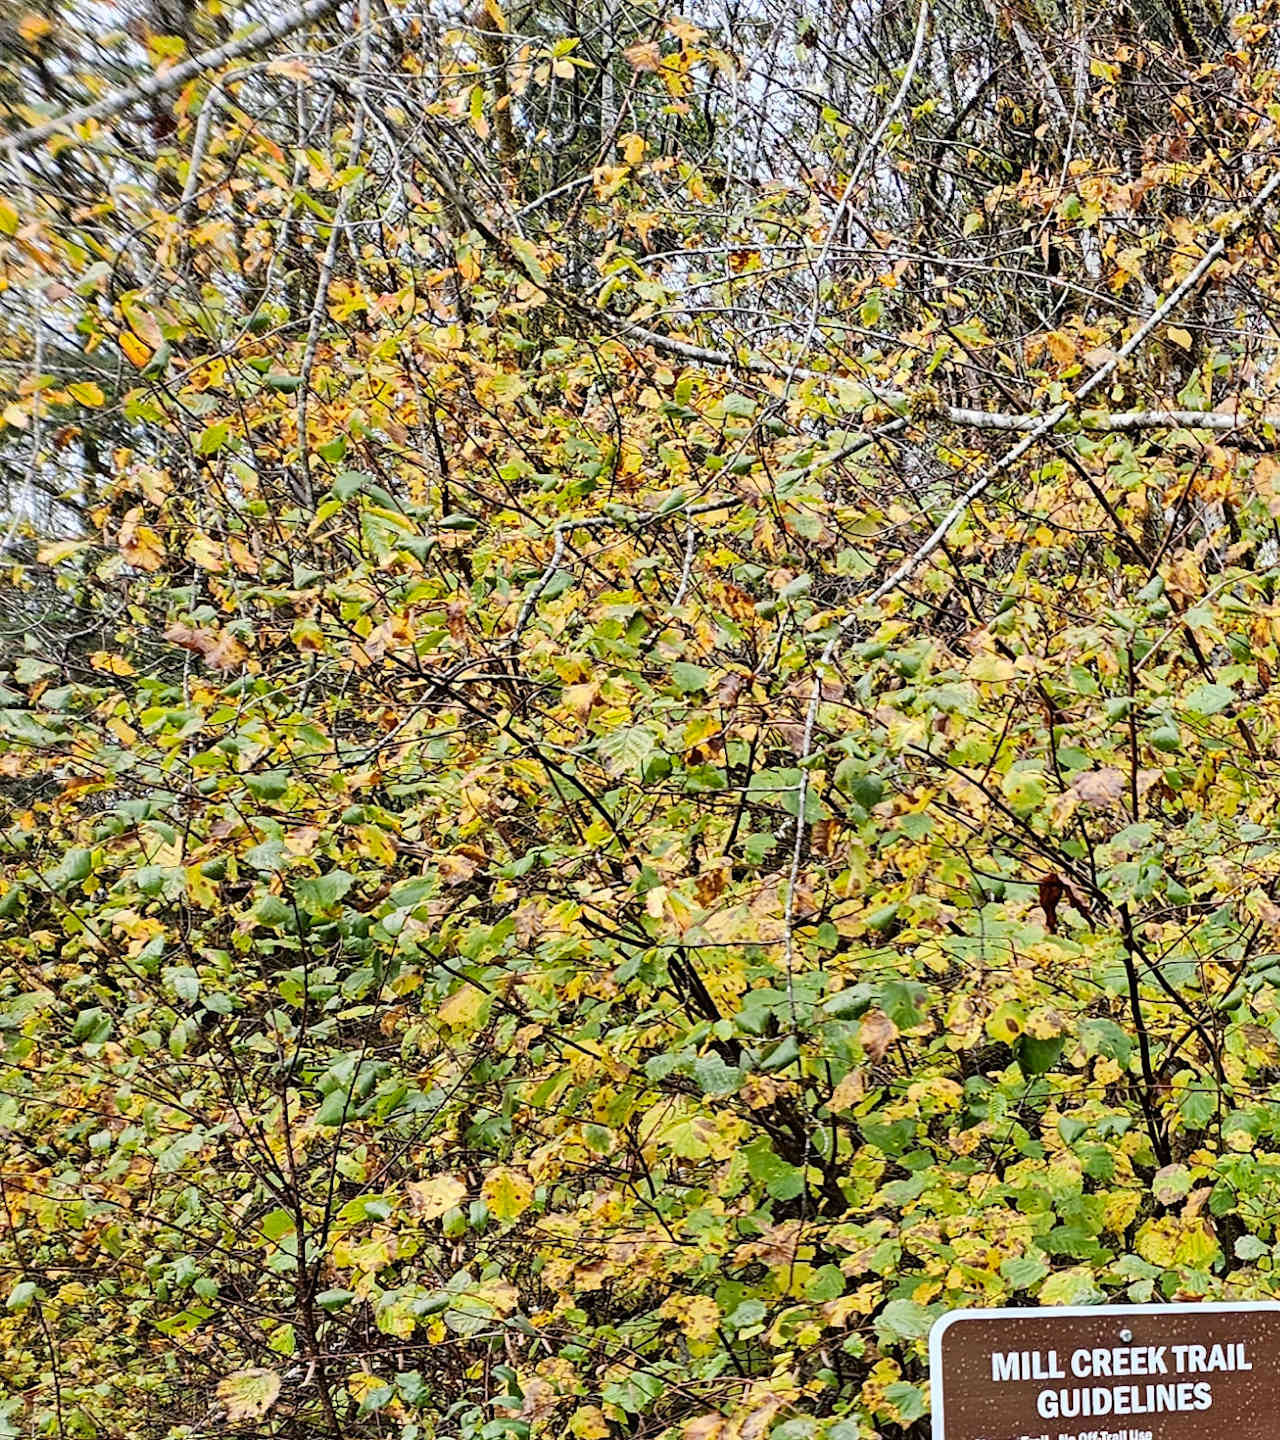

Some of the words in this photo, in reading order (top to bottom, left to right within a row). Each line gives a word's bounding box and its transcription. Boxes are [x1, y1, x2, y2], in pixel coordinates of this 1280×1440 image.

[991, 1351, 1065, 1381] MILL
[1070, 1346, 1167, 1377] CREEK
[1171, 1342, 1252, 1372] TRAIL
[1037, 1382, 1212, 1418] GUIDELINES
